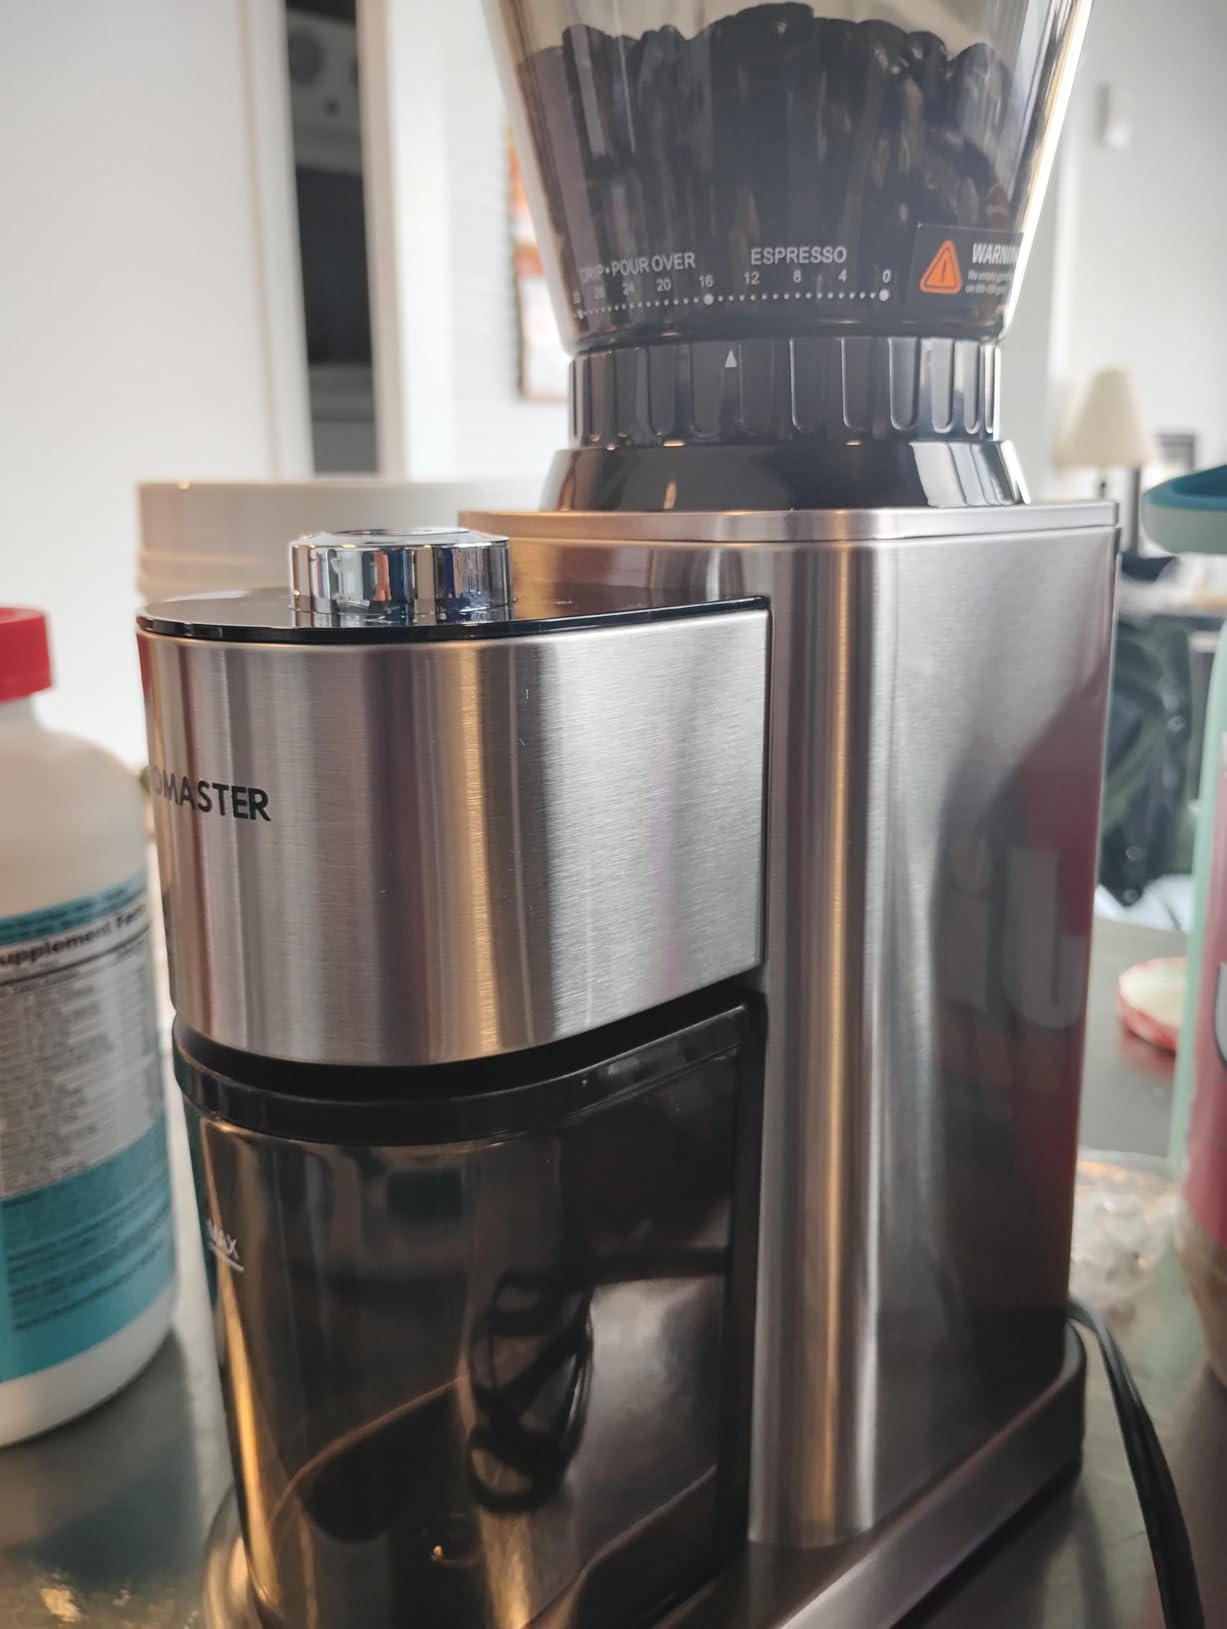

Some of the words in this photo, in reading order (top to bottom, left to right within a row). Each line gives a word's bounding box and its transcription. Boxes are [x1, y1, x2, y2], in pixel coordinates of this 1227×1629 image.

[611, 257, 650, 277] POUR
[652, 252, 696, 272] OVER
[751, 246, 848, 265] ESPRESSO
[622, 283, 635, 295] 24
[656, 278, 672, 291] 20
[699, 274, 714, 288] 16
[744, 271, 760, 285] 12
[793, 270, 802, 283] 8
[838, 269, 847, 282] 4
[882, 269, 891, 283] 0
